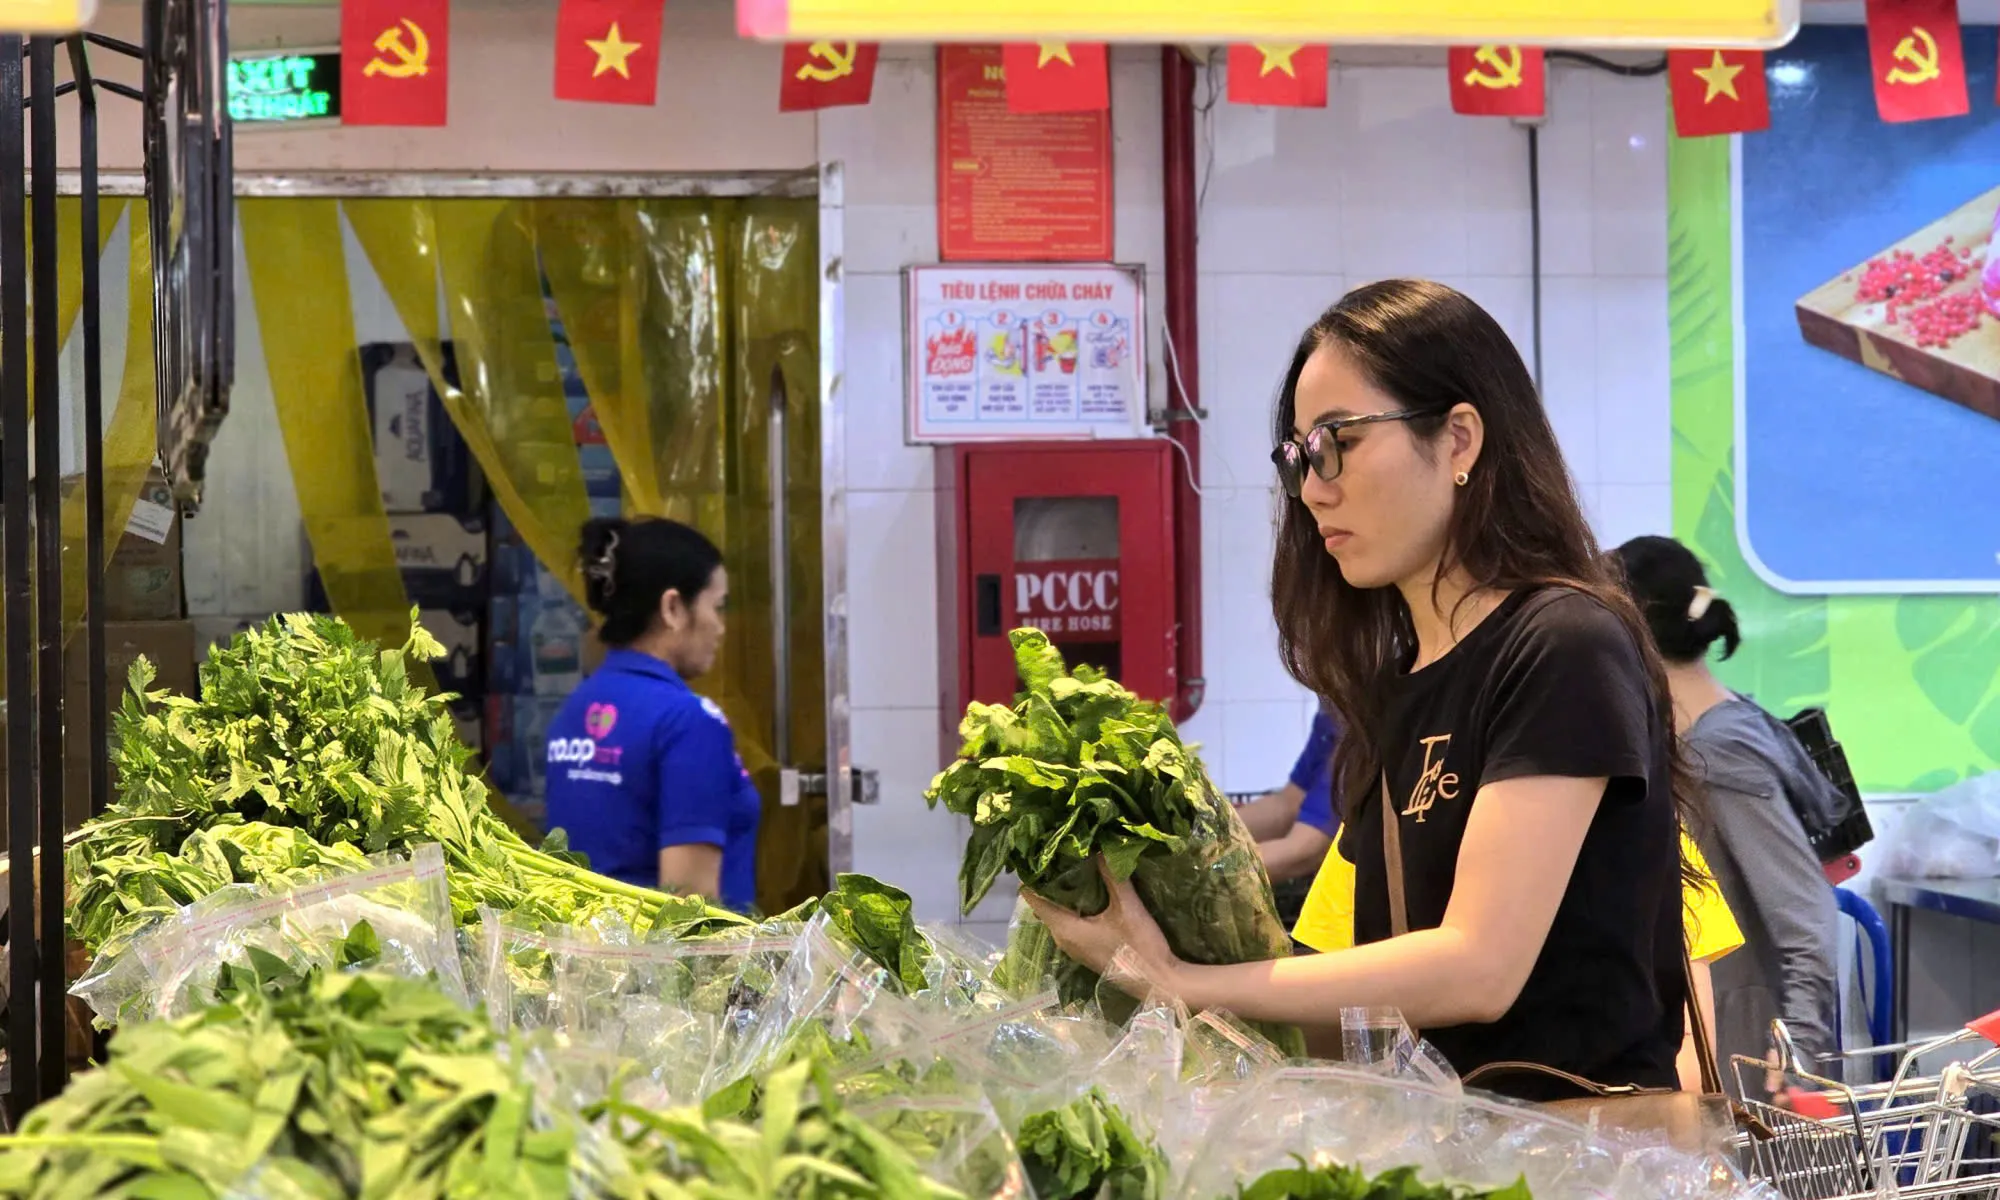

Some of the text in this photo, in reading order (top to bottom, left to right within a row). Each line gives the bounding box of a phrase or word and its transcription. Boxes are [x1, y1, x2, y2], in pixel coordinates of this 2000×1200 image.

[941, 280, 1113, 302] TIÊU LỆNH CHỮA CHÁY
[947, 313, 955, 324] 1
[998, 313, 1007, 325] 2
[1049, 313, 1058, 325] 3
[1015, 570, 1118, 613] PCCC
[1068, 616, 1112, 631] HOSE
